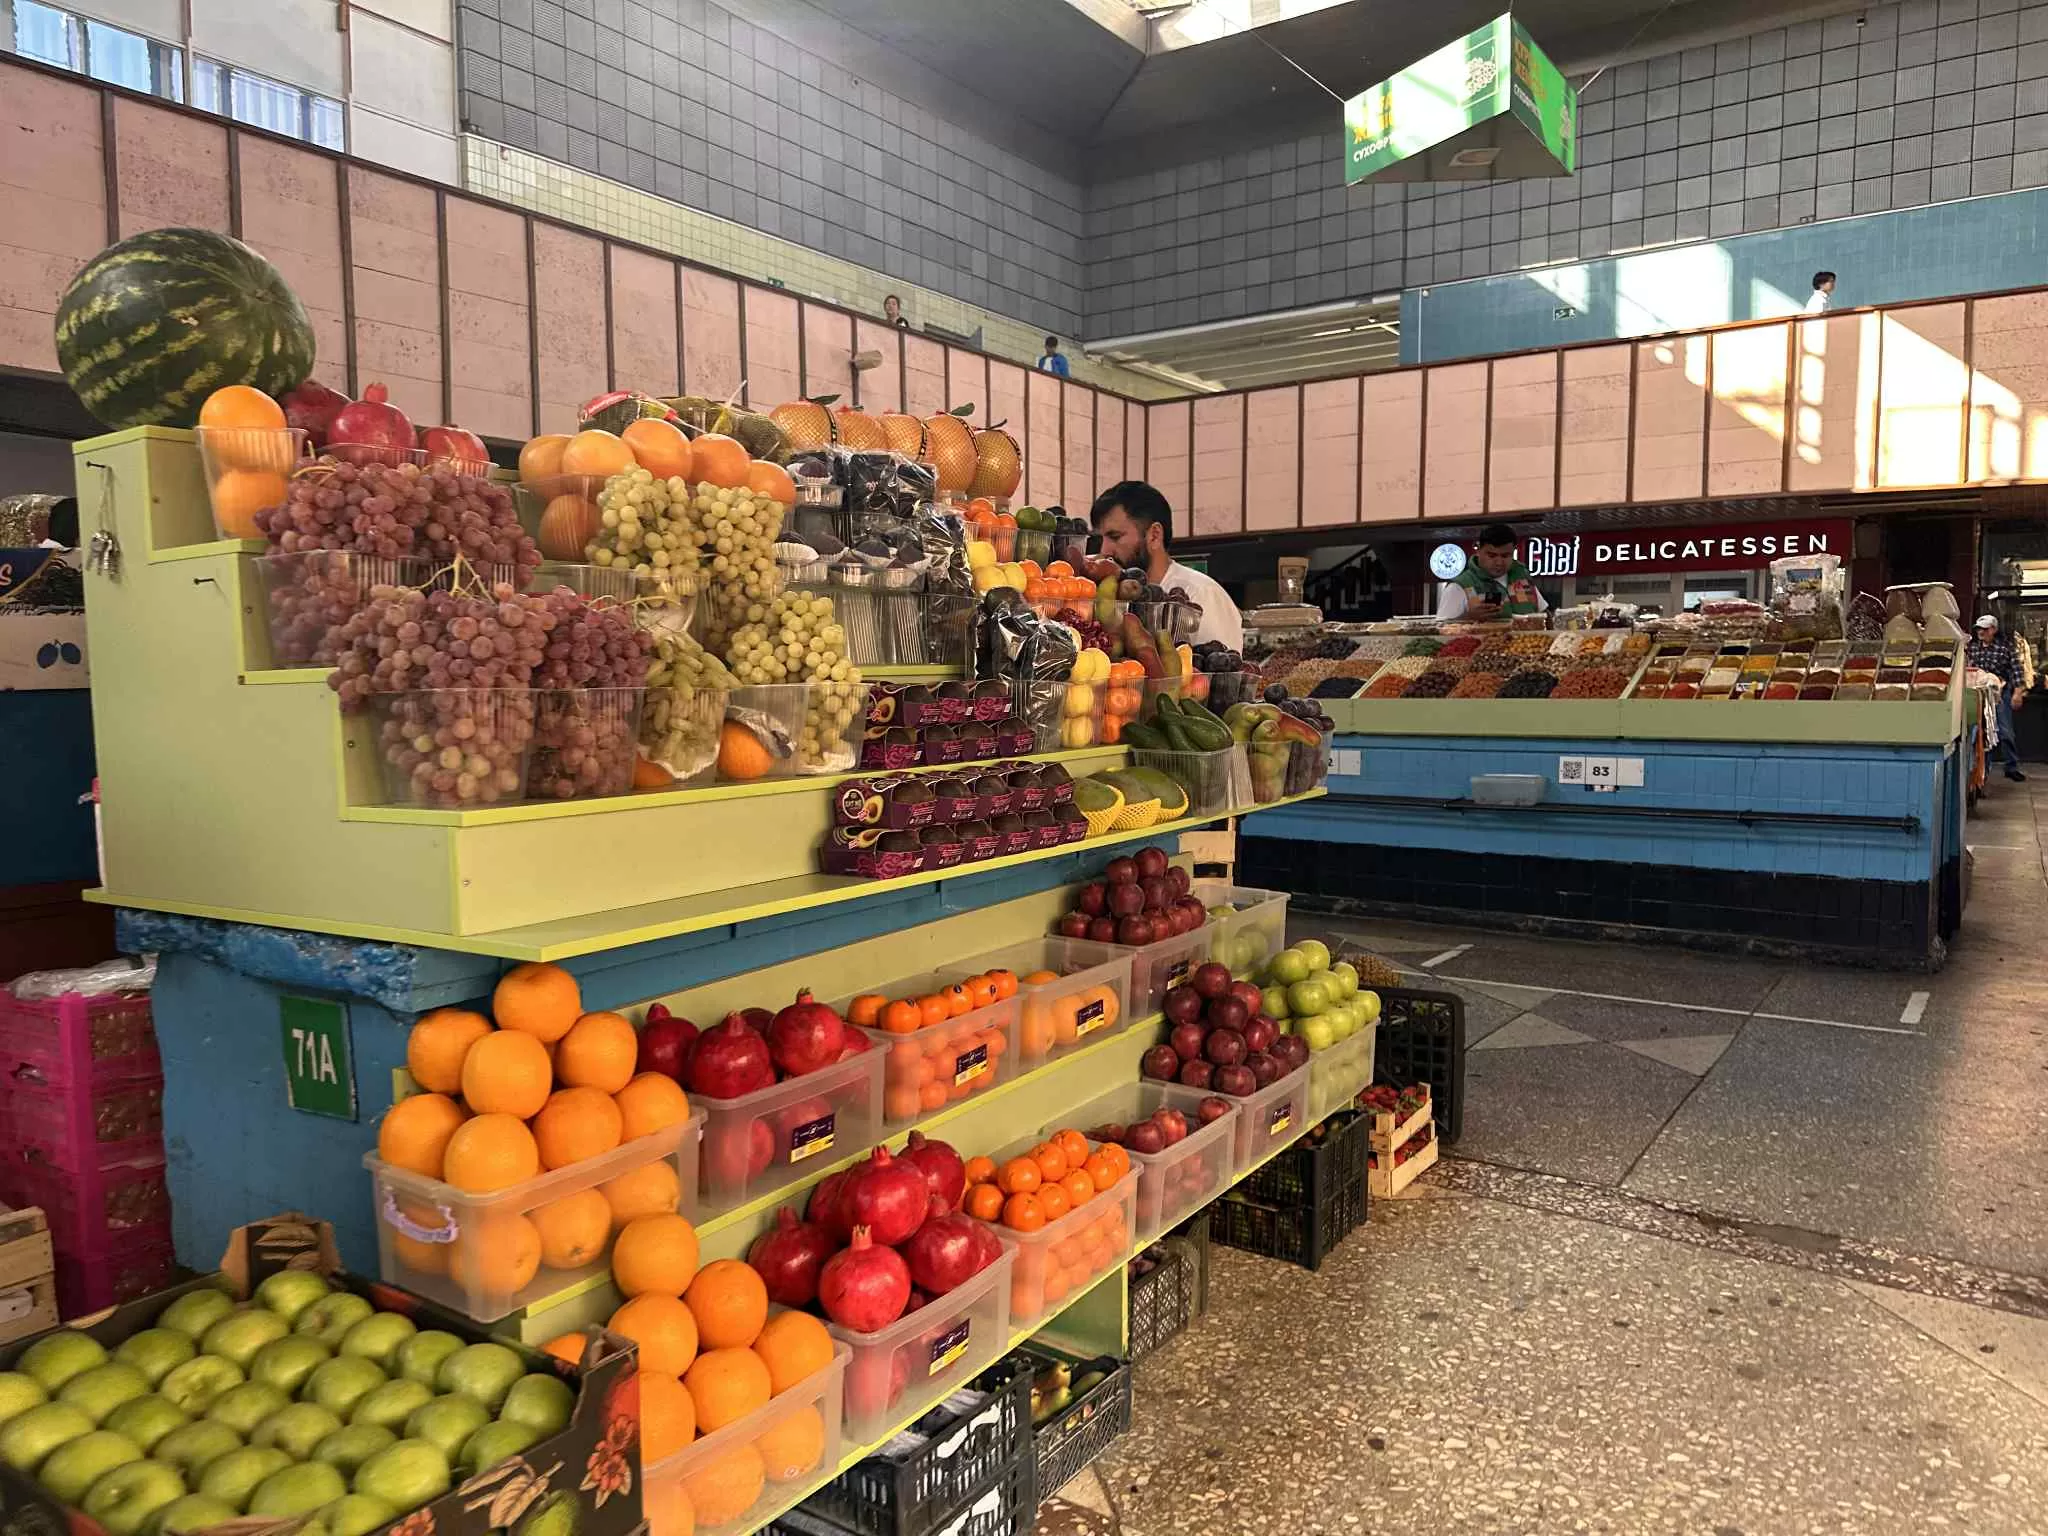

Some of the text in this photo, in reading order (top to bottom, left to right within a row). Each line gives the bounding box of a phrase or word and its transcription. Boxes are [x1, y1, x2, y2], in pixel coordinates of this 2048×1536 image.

[1528, 535, 1581, 577] Chef
[1595, 534, 1827, 562] DELICATESSEN
[1592, 766, 1610, 777] 83
